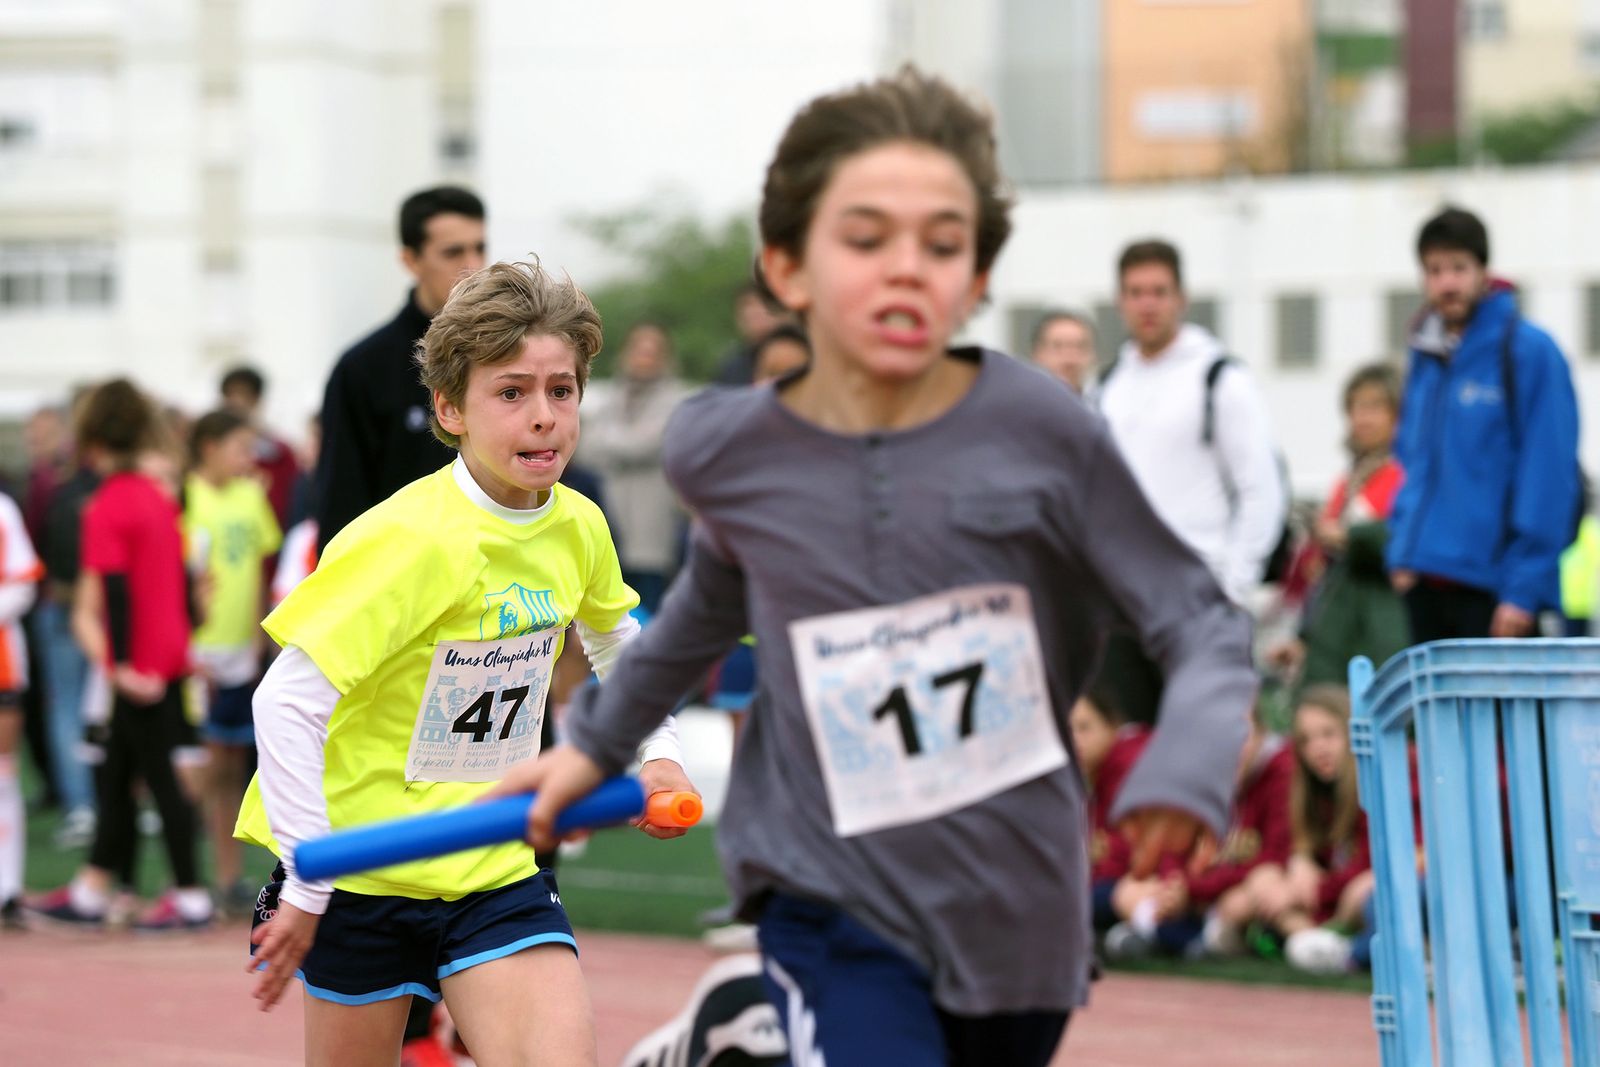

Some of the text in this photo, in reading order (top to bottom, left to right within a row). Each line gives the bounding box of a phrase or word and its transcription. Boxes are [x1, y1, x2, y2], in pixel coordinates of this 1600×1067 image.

[445, 648, 482, 666] Unas
[483, 642, 541, 671] Olimpiadas
[452, 685, 530, 742] 47
[872, 661, 985, 758] 17
